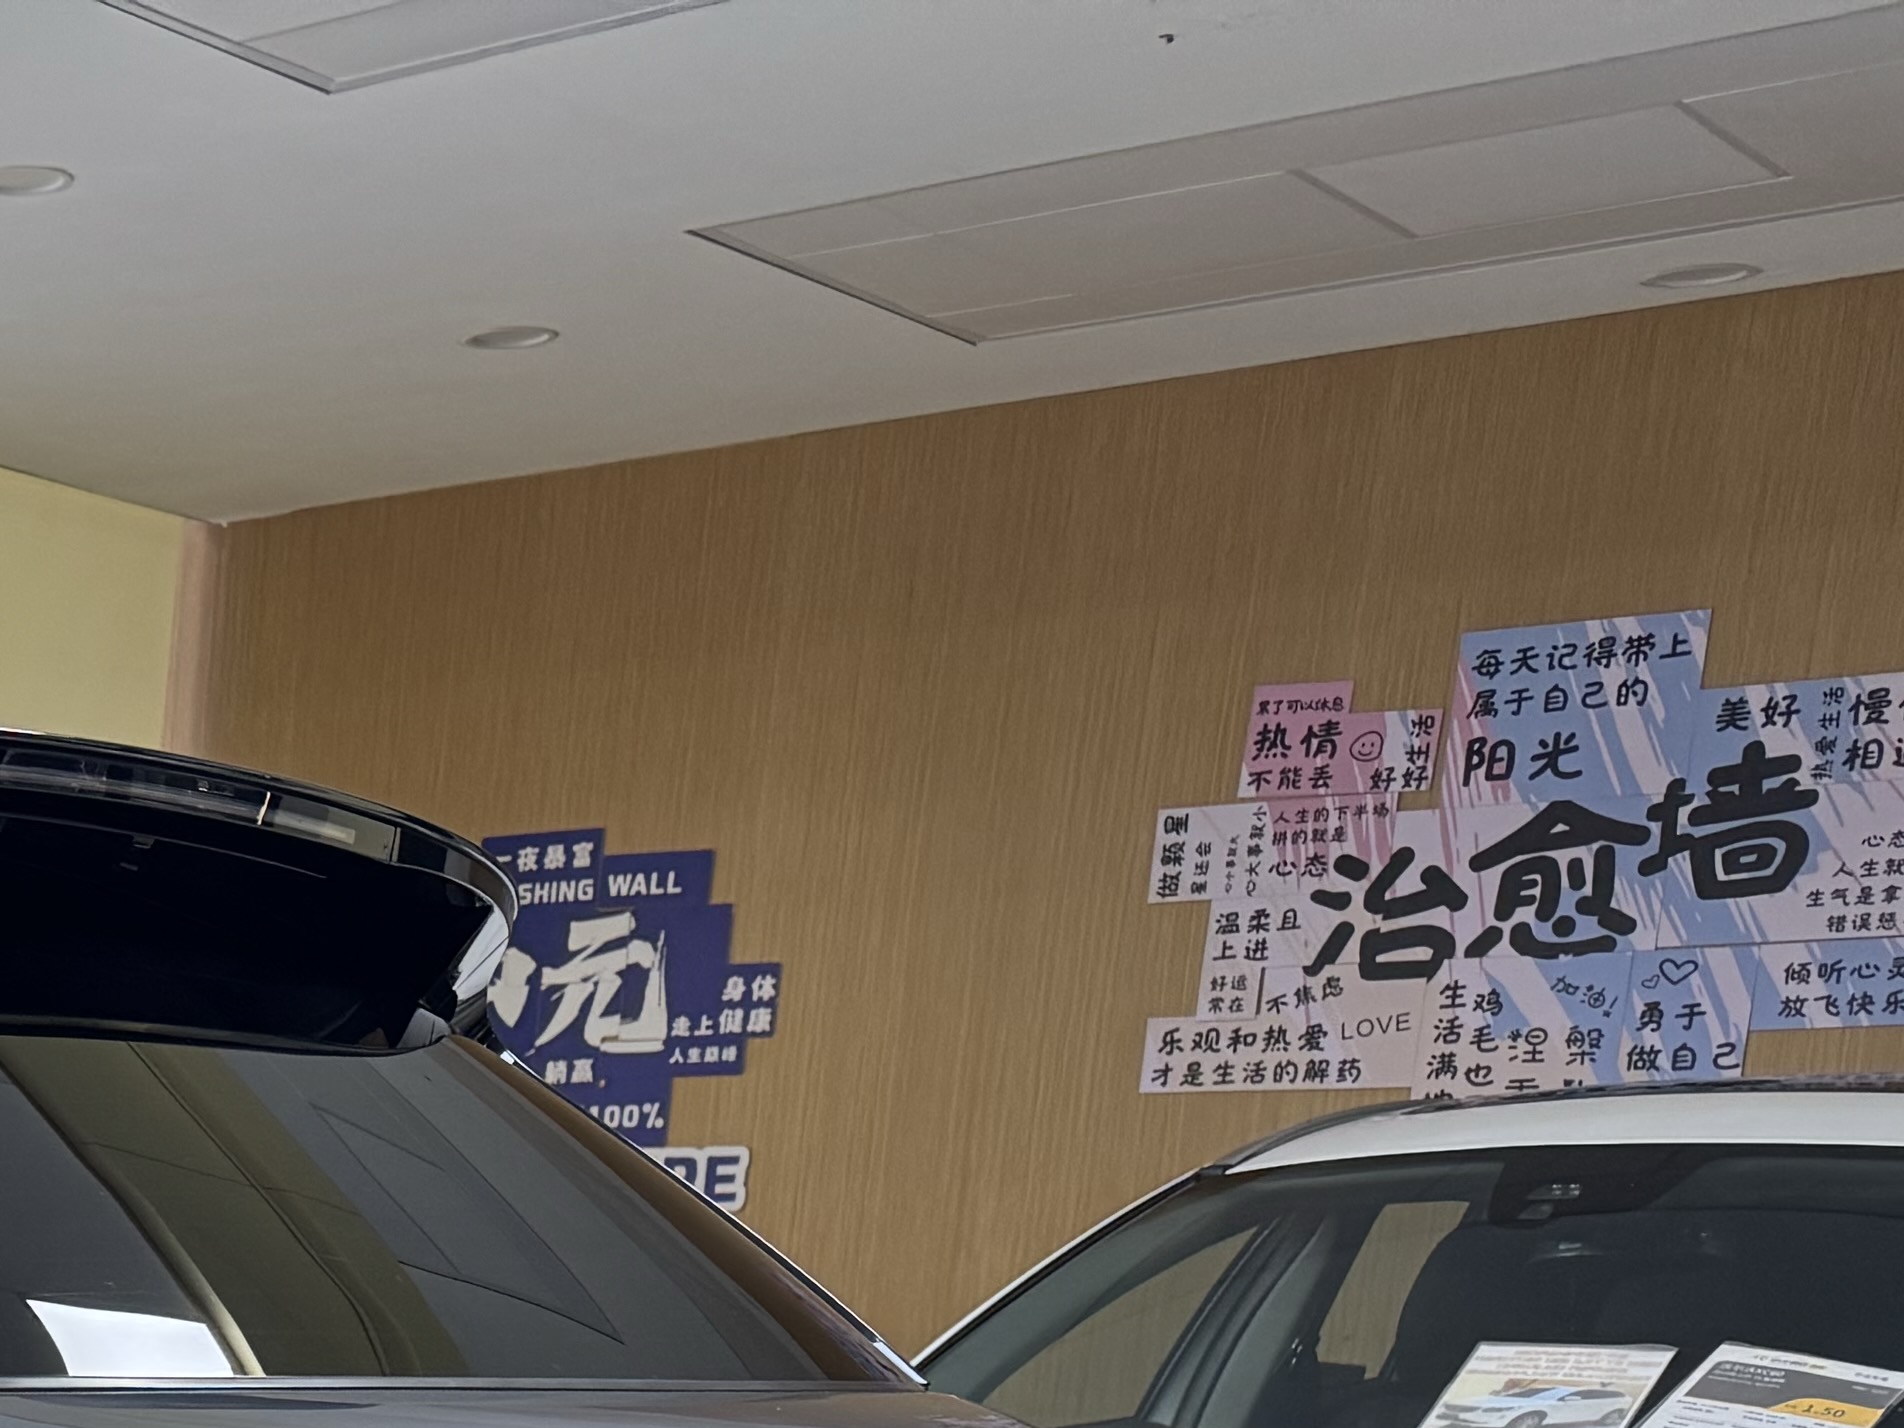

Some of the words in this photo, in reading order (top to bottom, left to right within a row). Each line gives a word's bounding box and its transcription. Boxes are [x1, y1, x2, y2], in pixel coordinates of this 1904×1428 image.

[1471, 632, 1693, 680] 每天记得带上
[1256, 696, 1345, 716] 累了可以休息
[1466, 678, 1649, 720] 属于自己的
[1715, 694, 1802, 732] 美好
[1848, 687, 1904, 727] 慢
[1252, 720, 1343, 761] 热情
[1462, 731, 1583, 787] 阳光
[1247, 764, 1334, 792] 不能丢
[1369, 765, 1429, 792] 好好
[1273, 802, 1389, 824] 人生的下半场
[1272, 827, 1348, 846] 拼的就是
[496, 842, 594, 872] 一夜暴富
[1268, 852, 1329, 878] 心态
[1301, 740, 1820, 982] 治愈墙
[608, 871, 682, 897] WALL
[1216, 908, 1301, 935] 温柔且
[1212, 937, 1269, 961] 上进
[721, 975, 776, 1002] 身体
[1265, 975, 1344, 1015] 不焦虑
[1209, 996, 1244, 1014] 常在
[1639, 1000, 1707, 1032] 勇于
[1778, 989, 1904, 1018] 放飞快乐
[719, 1007, 772, 1034] 健康
[1341, 1012, 1412, 1041] LOVE
[1158, 1023, 1328, 1055] 乐观和热爱
[1626, 1042, 1740, 1072] 做自己
[1151, 1058, 1362, 1087] 才是生活的解药
